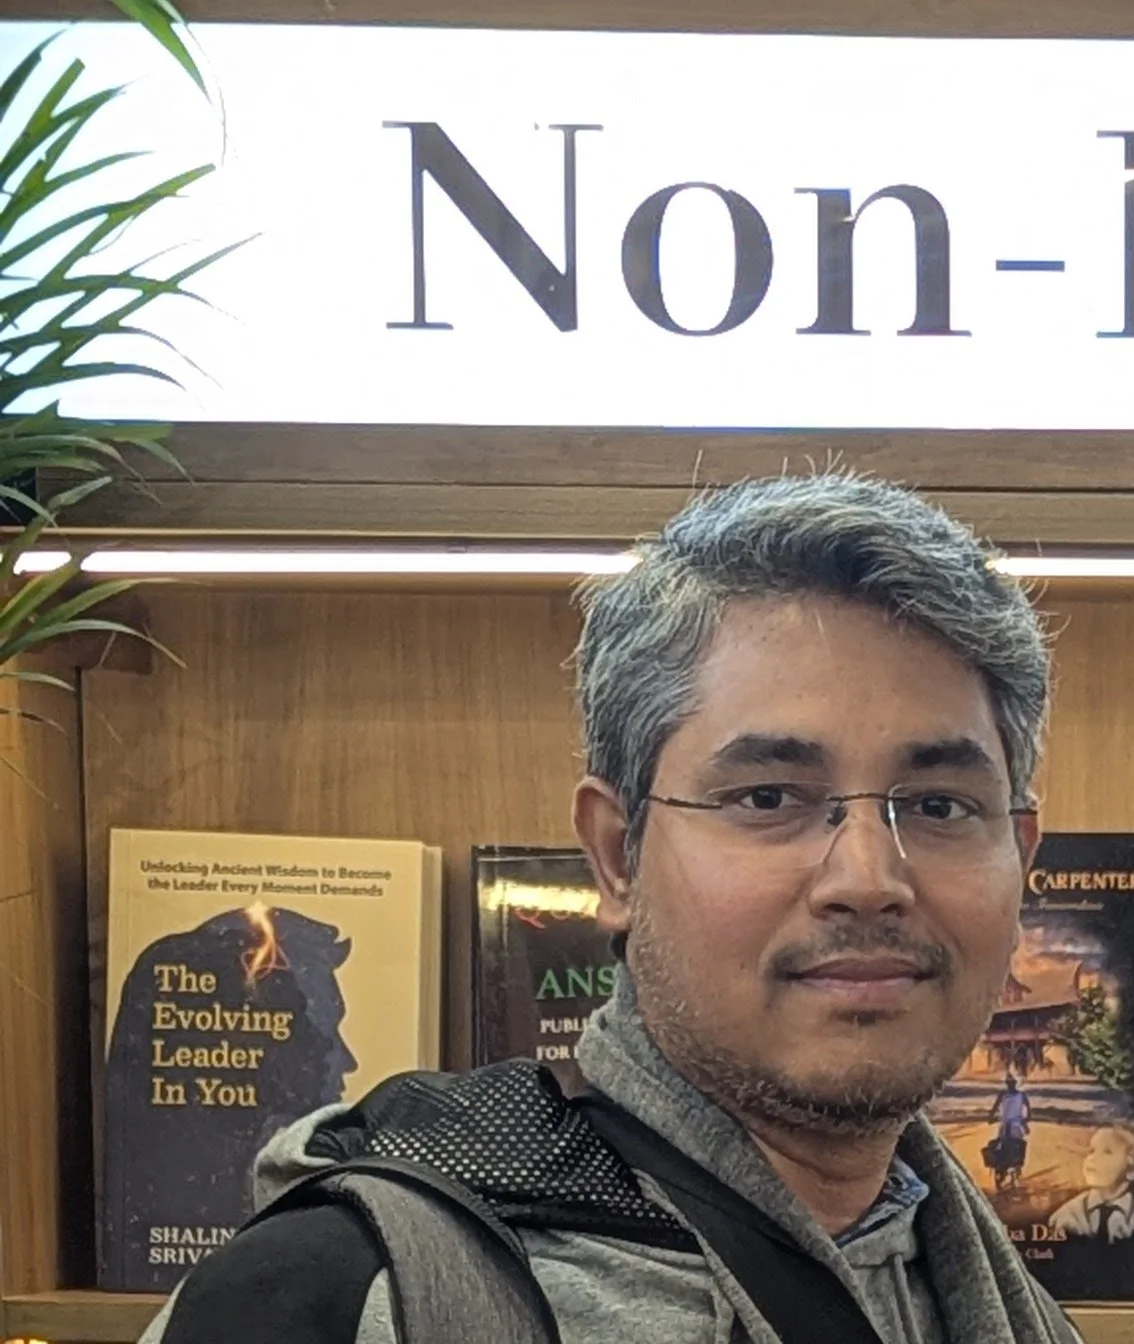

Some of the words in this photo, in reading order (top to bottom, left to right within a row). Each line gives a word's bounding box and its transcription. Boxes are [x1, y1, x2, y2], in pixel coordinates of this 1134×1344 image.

[211, 863, 263, 876] Ancient
[265, 865, 318, 877] Wisdom
[321, 867, 336, 878] to
[338, 868, 392, 880] Become
[147, 878, 170, 889] the
[173, 880, 218, 891] Leader
[221, 881, 258, 895] Every
[262, 884, 318, 894] Moment
[320, 884, 383, 897] Demands
[154, 964, 217, 993] The
[152, 1002, 293, 1040] Evolving
[152, 1039, 264, 1069] Leader
[536, 1046, 570, 1061] FOR
[152, 1077, 187, 1105] In
[195, 1078, 258, 1107] You
